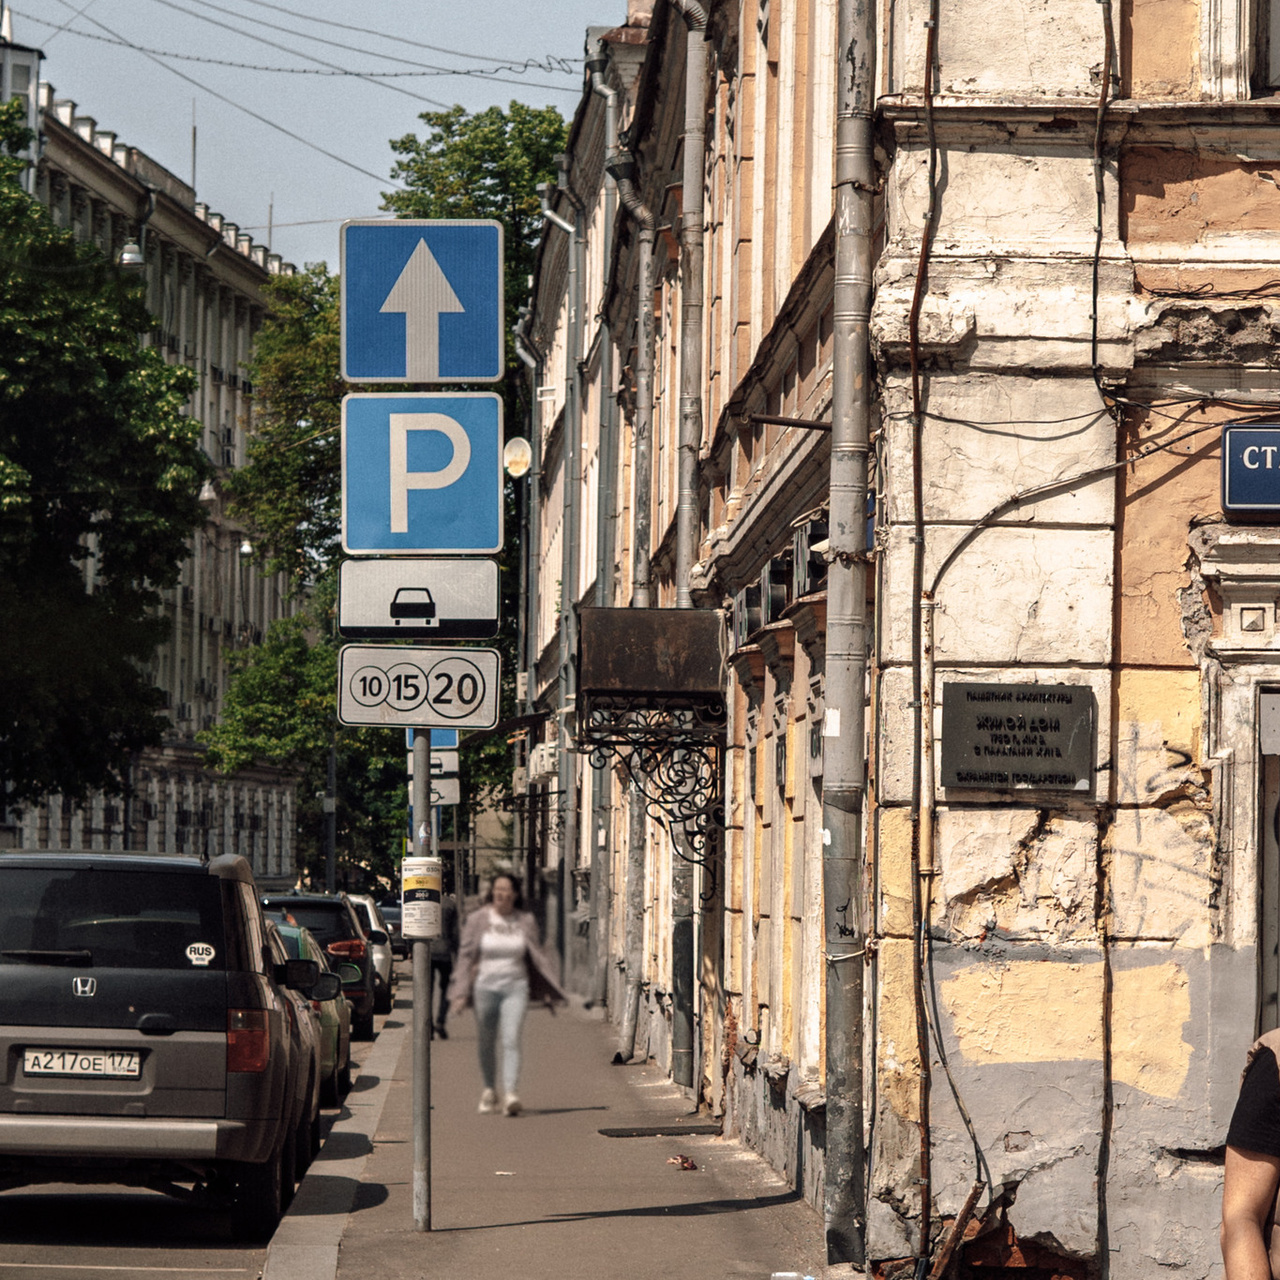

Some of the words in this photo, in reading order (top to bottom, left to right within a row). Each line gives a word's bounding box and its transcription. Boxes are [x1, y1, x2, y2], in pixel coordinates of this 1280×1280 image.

[389, 412, 472, 533] P
[359, 676, 383, 697] 10
[392, 674, 421, 701] 15
[432, 673, 478, 705] 20
[189, 947, 212, 957] RUS
